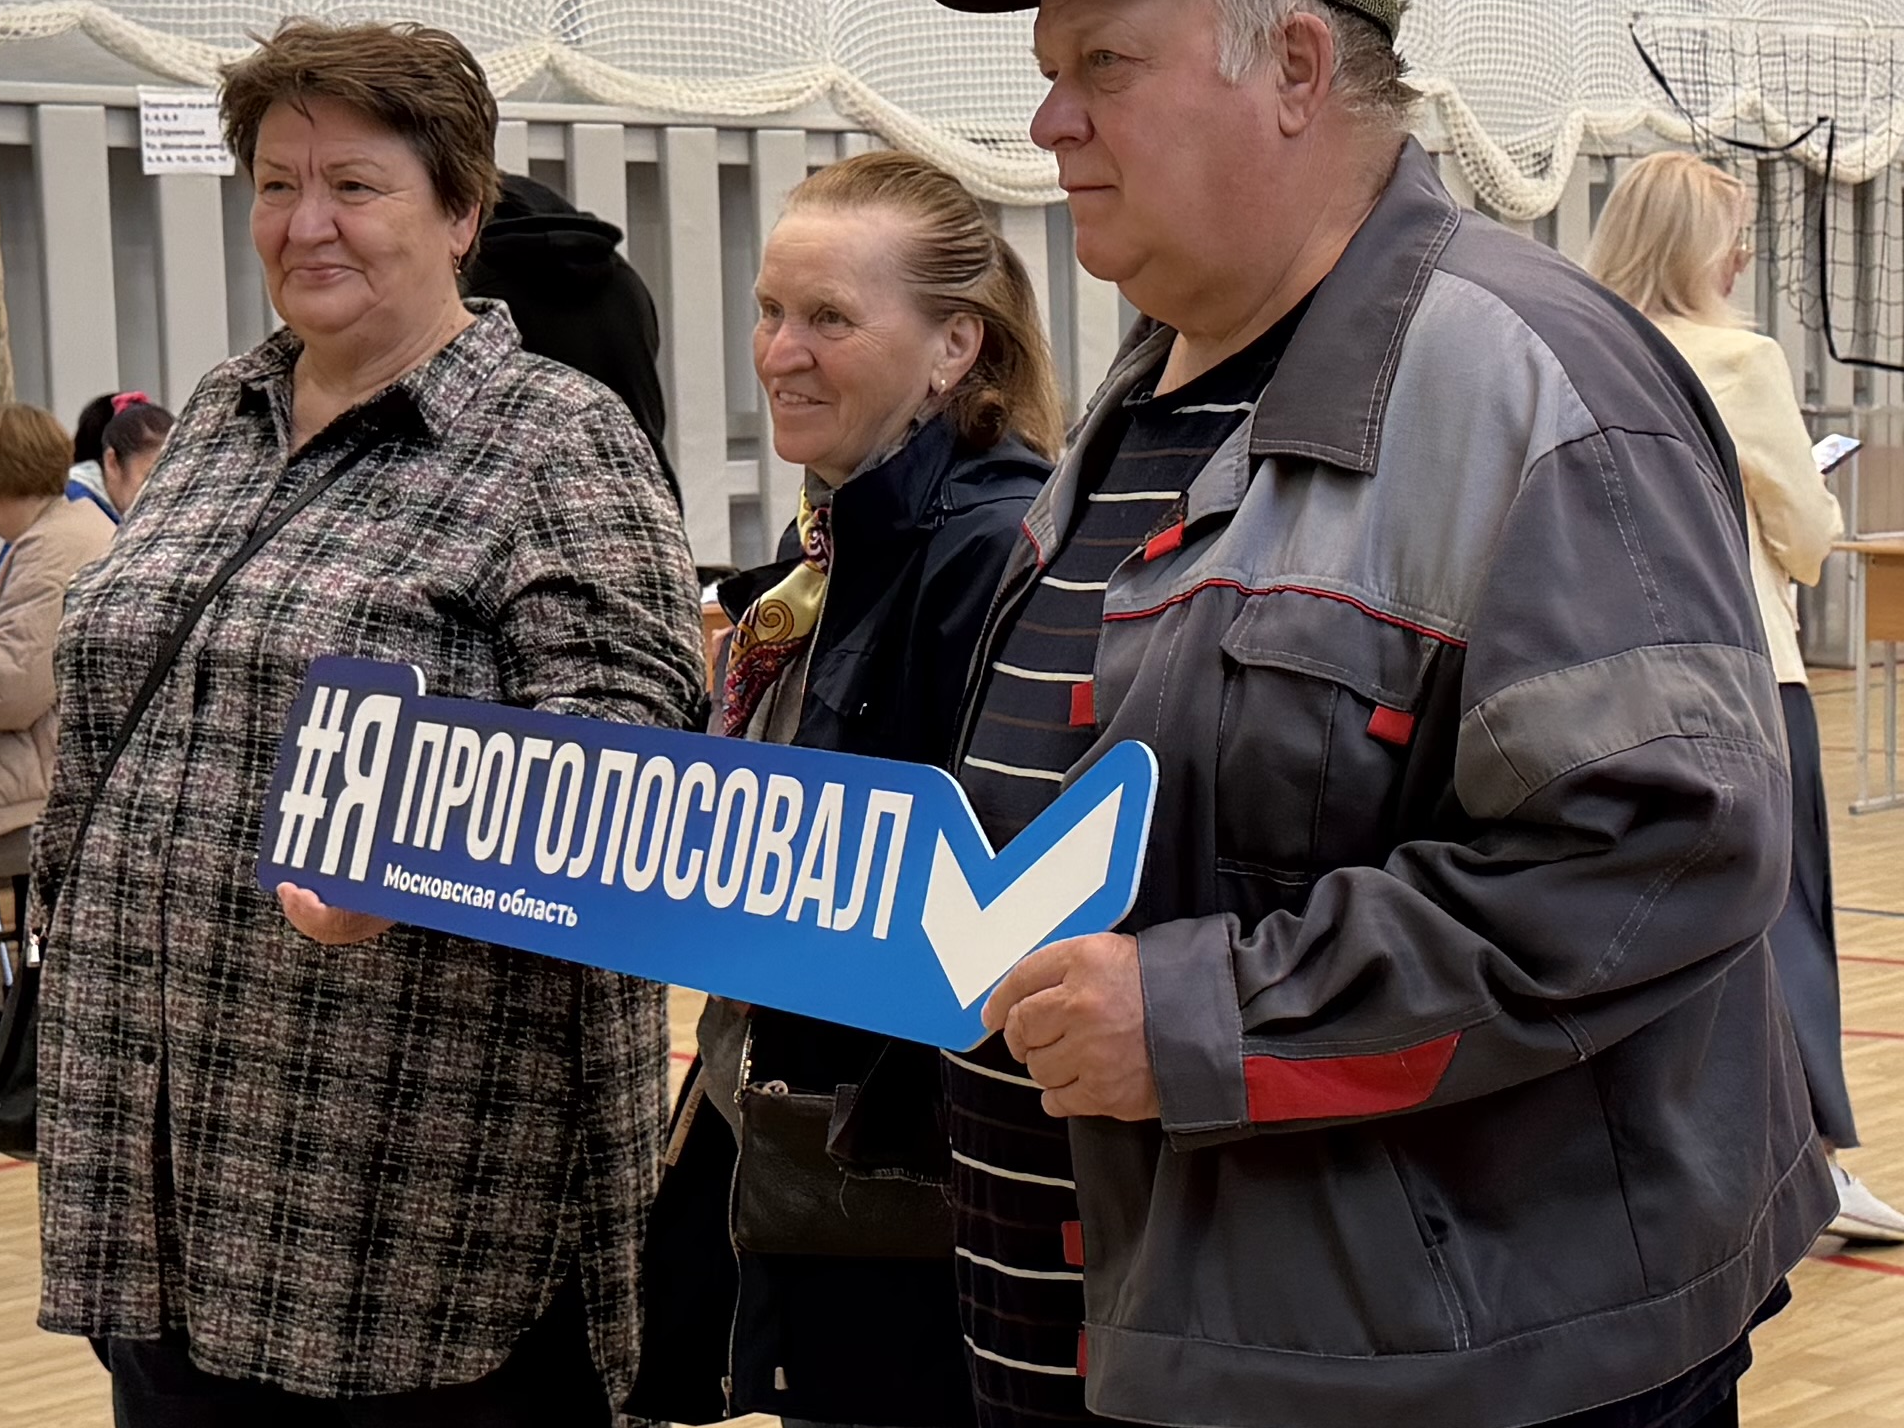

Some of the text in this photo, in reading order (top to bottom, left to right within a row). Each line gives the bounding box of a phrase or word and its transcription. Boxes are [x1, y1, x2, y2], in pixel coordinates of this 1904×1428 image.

[382, 862, 579, 928] Московская область
[392, 720, 914, 940] ПРОГОЛОСОВАЛ
